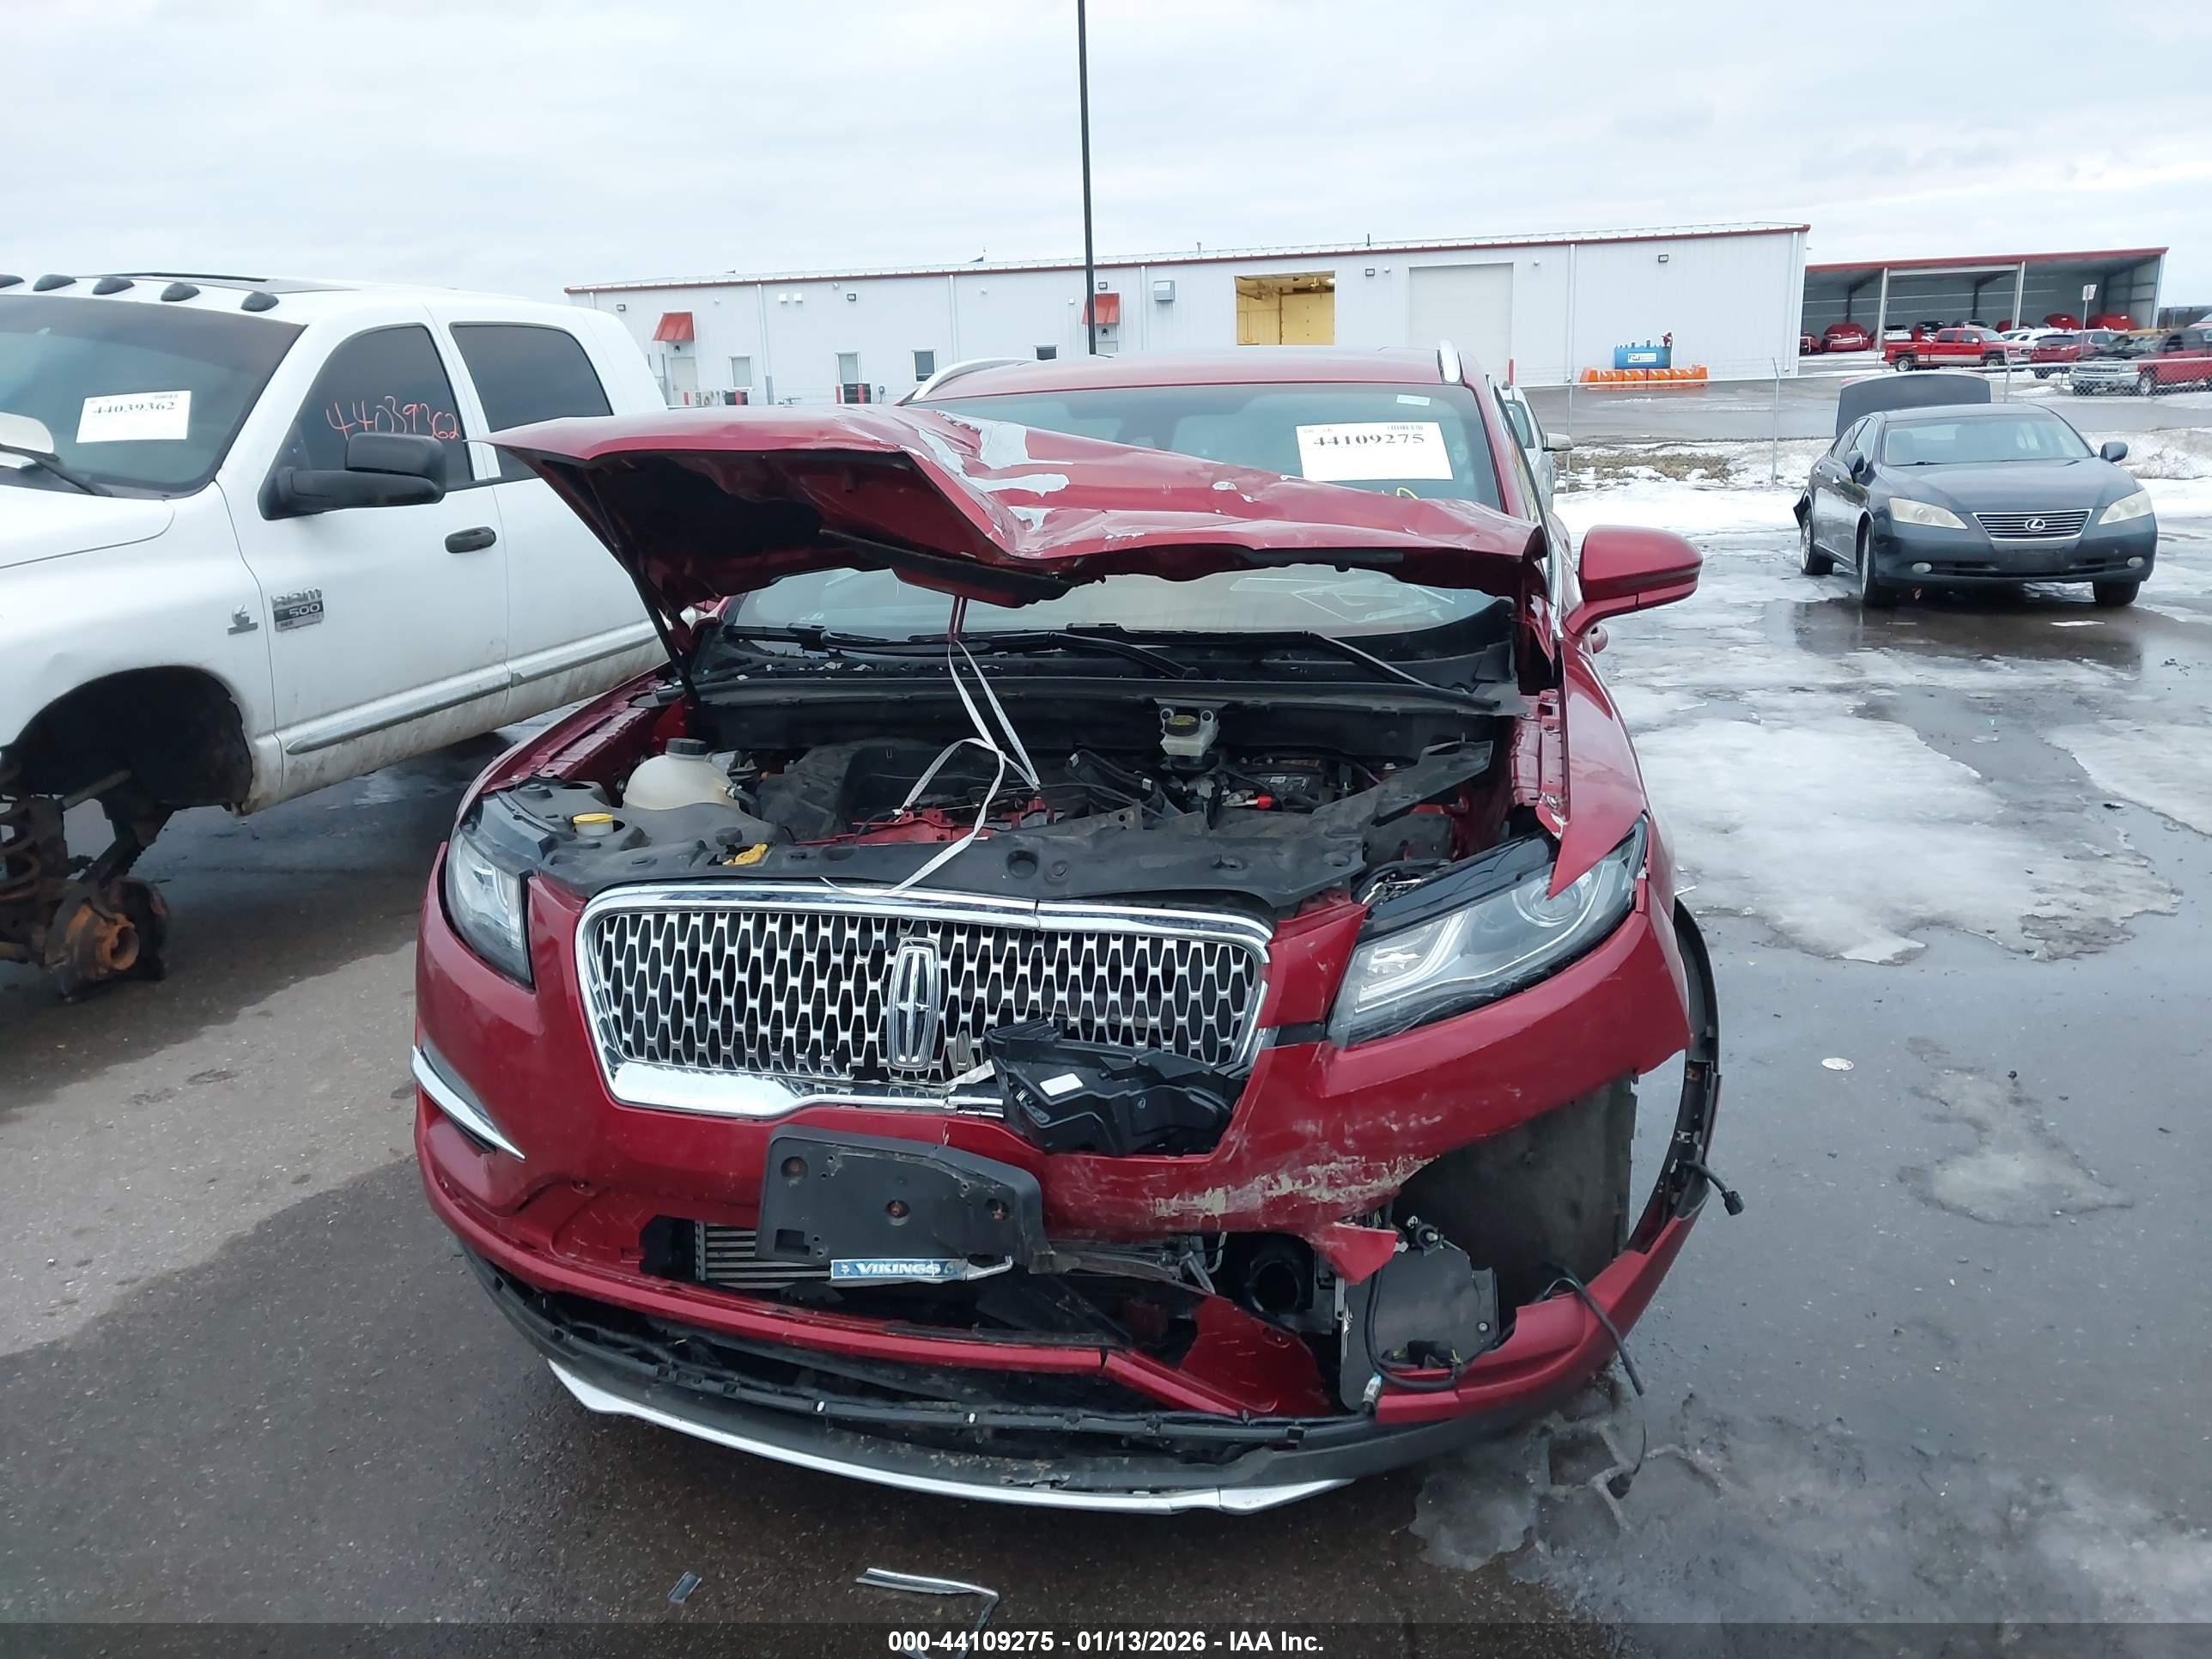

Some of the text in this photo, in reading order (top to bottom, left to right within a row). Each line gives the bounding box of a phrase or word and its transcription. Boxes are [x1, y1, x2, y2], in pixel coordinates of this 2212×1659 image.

[92, 401, 176, 415] 44039362
[1313, 433, 1425, 447] 44109275
[856, 1262, 941, 1275] VIKINGS
